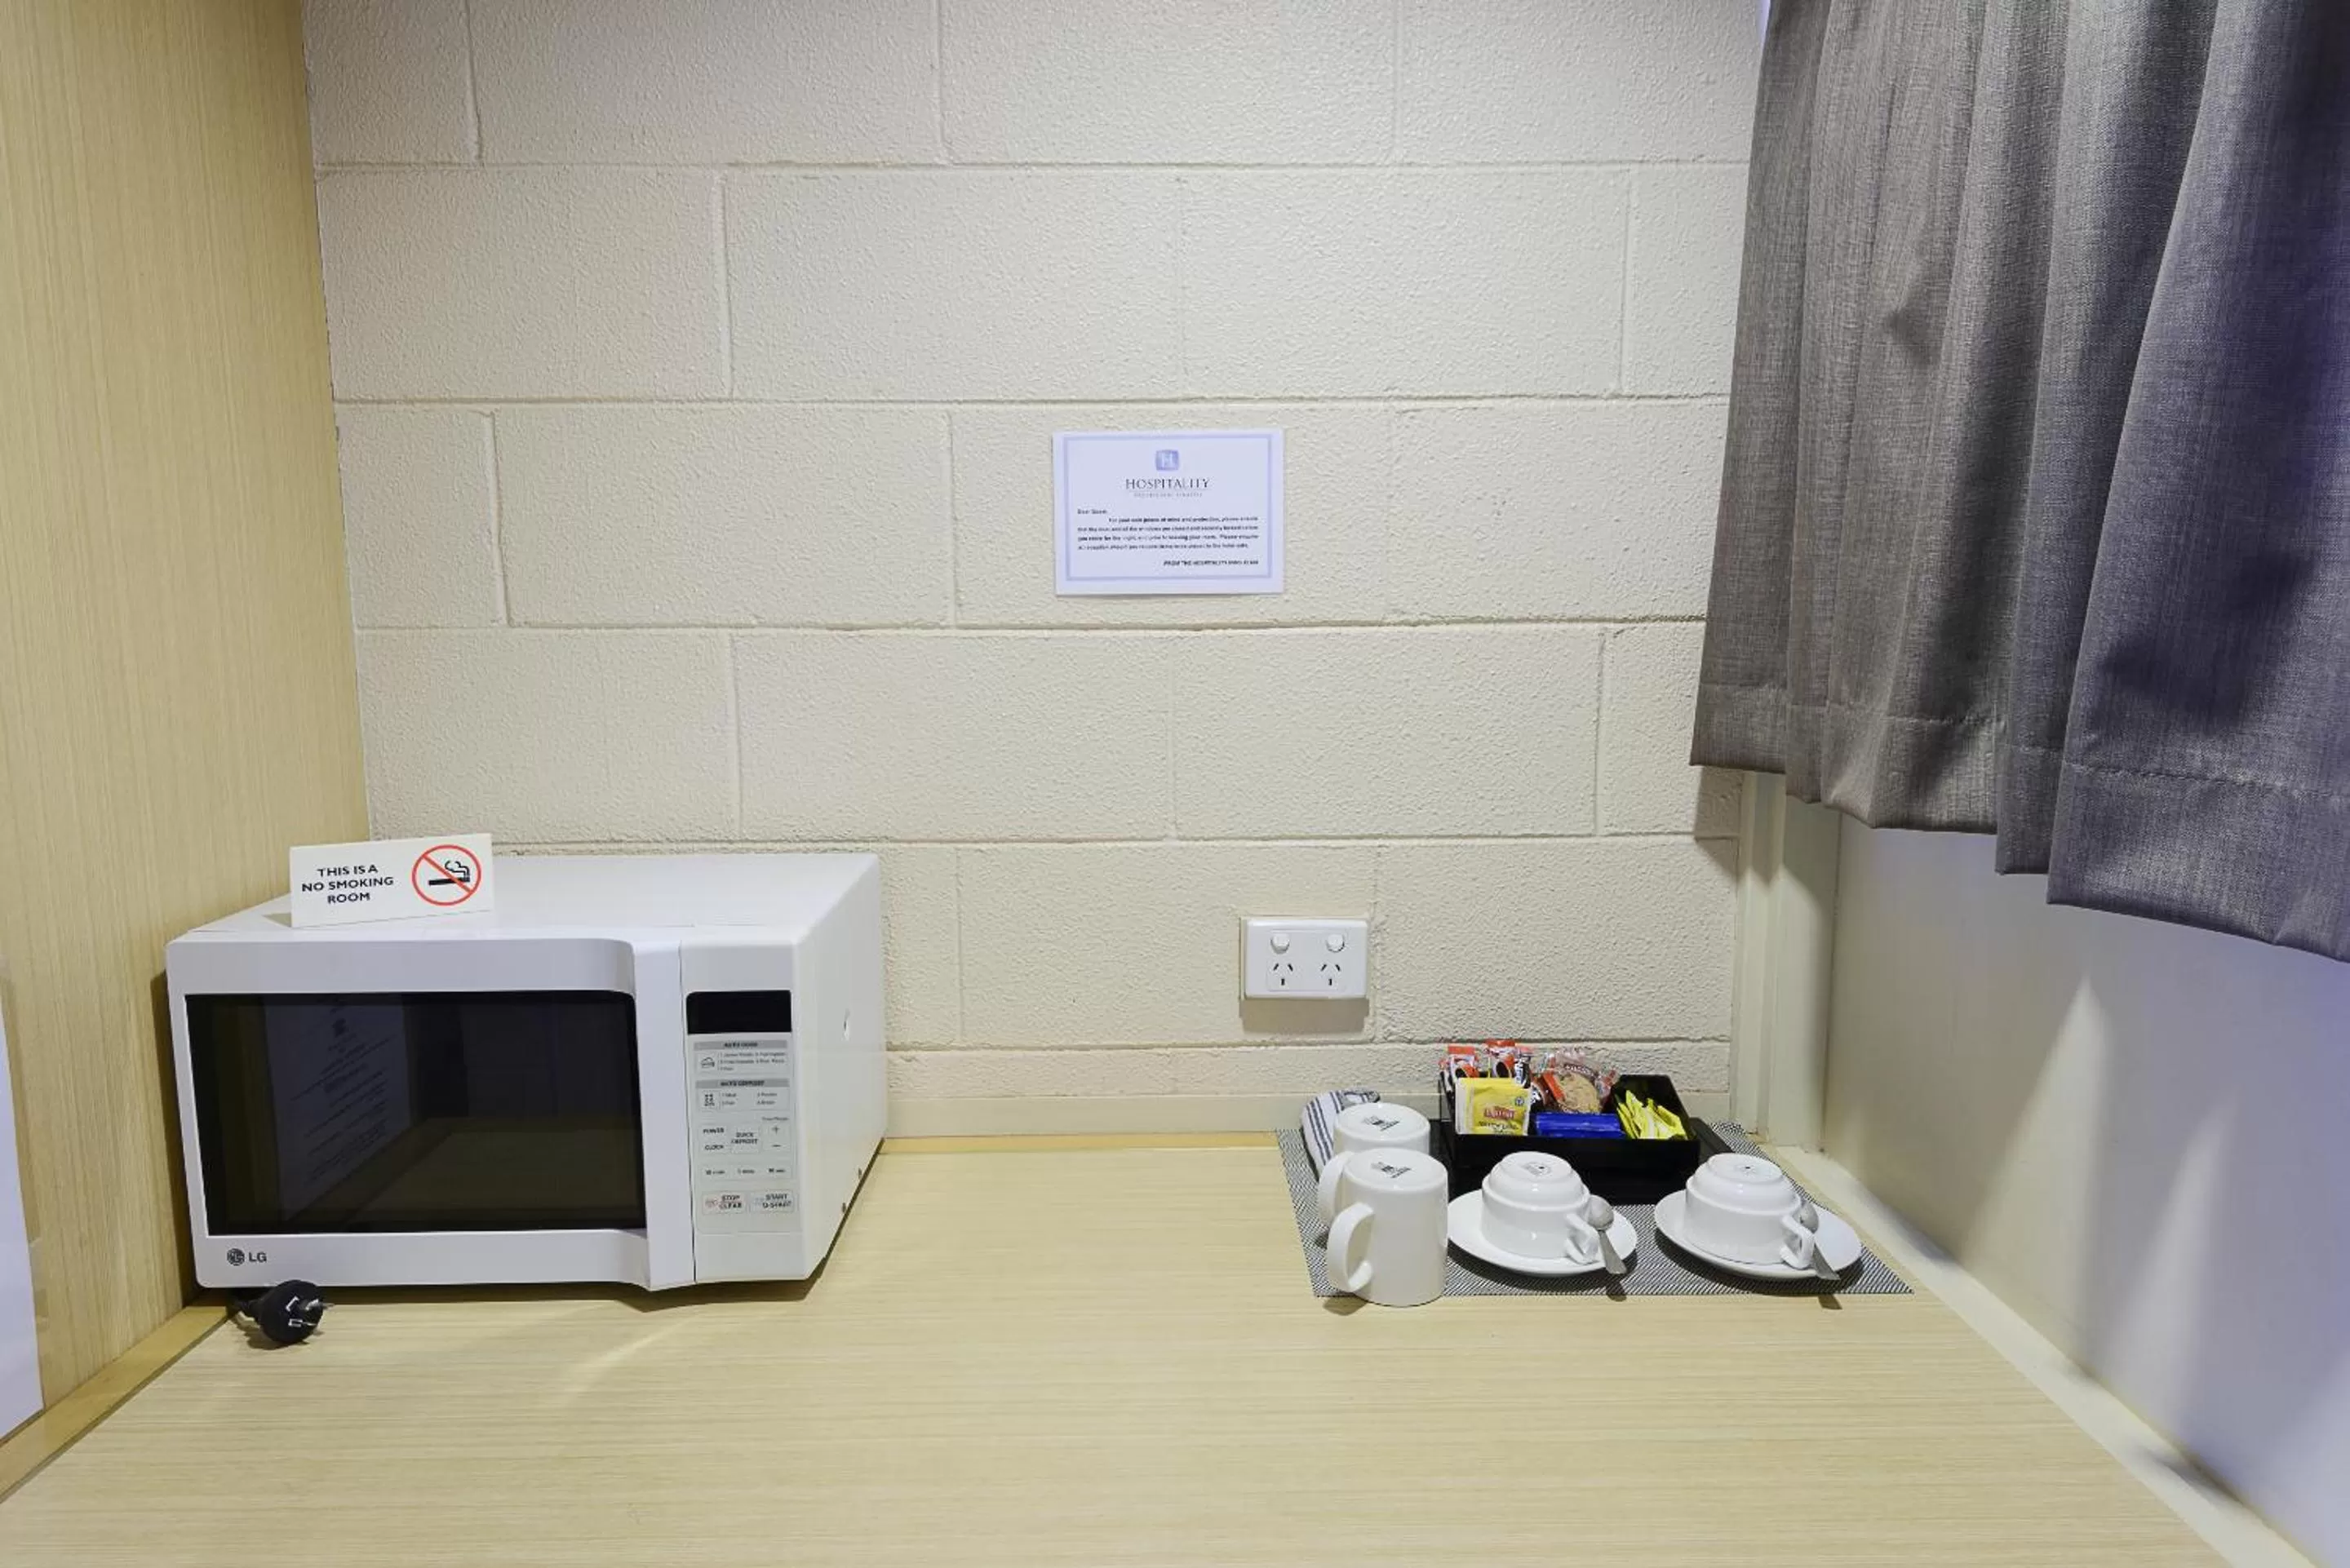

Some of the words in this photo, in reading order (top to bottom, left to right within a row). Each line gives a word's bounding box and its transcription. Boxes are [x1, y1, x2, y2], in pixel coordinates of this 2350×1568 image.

[1125, 479, 1209, 489] HOSPITALITY
[317, 866, 350, 877] THIS
[353, 865, 366, 875] IS
[367, 864, 379, 874] A
[302, 882, 325, 892] NO
[328, 876, 394, 891] SMOKING
[327, 893, 371, 905] ROOM
[248, 1251, 268, 1264] LG
